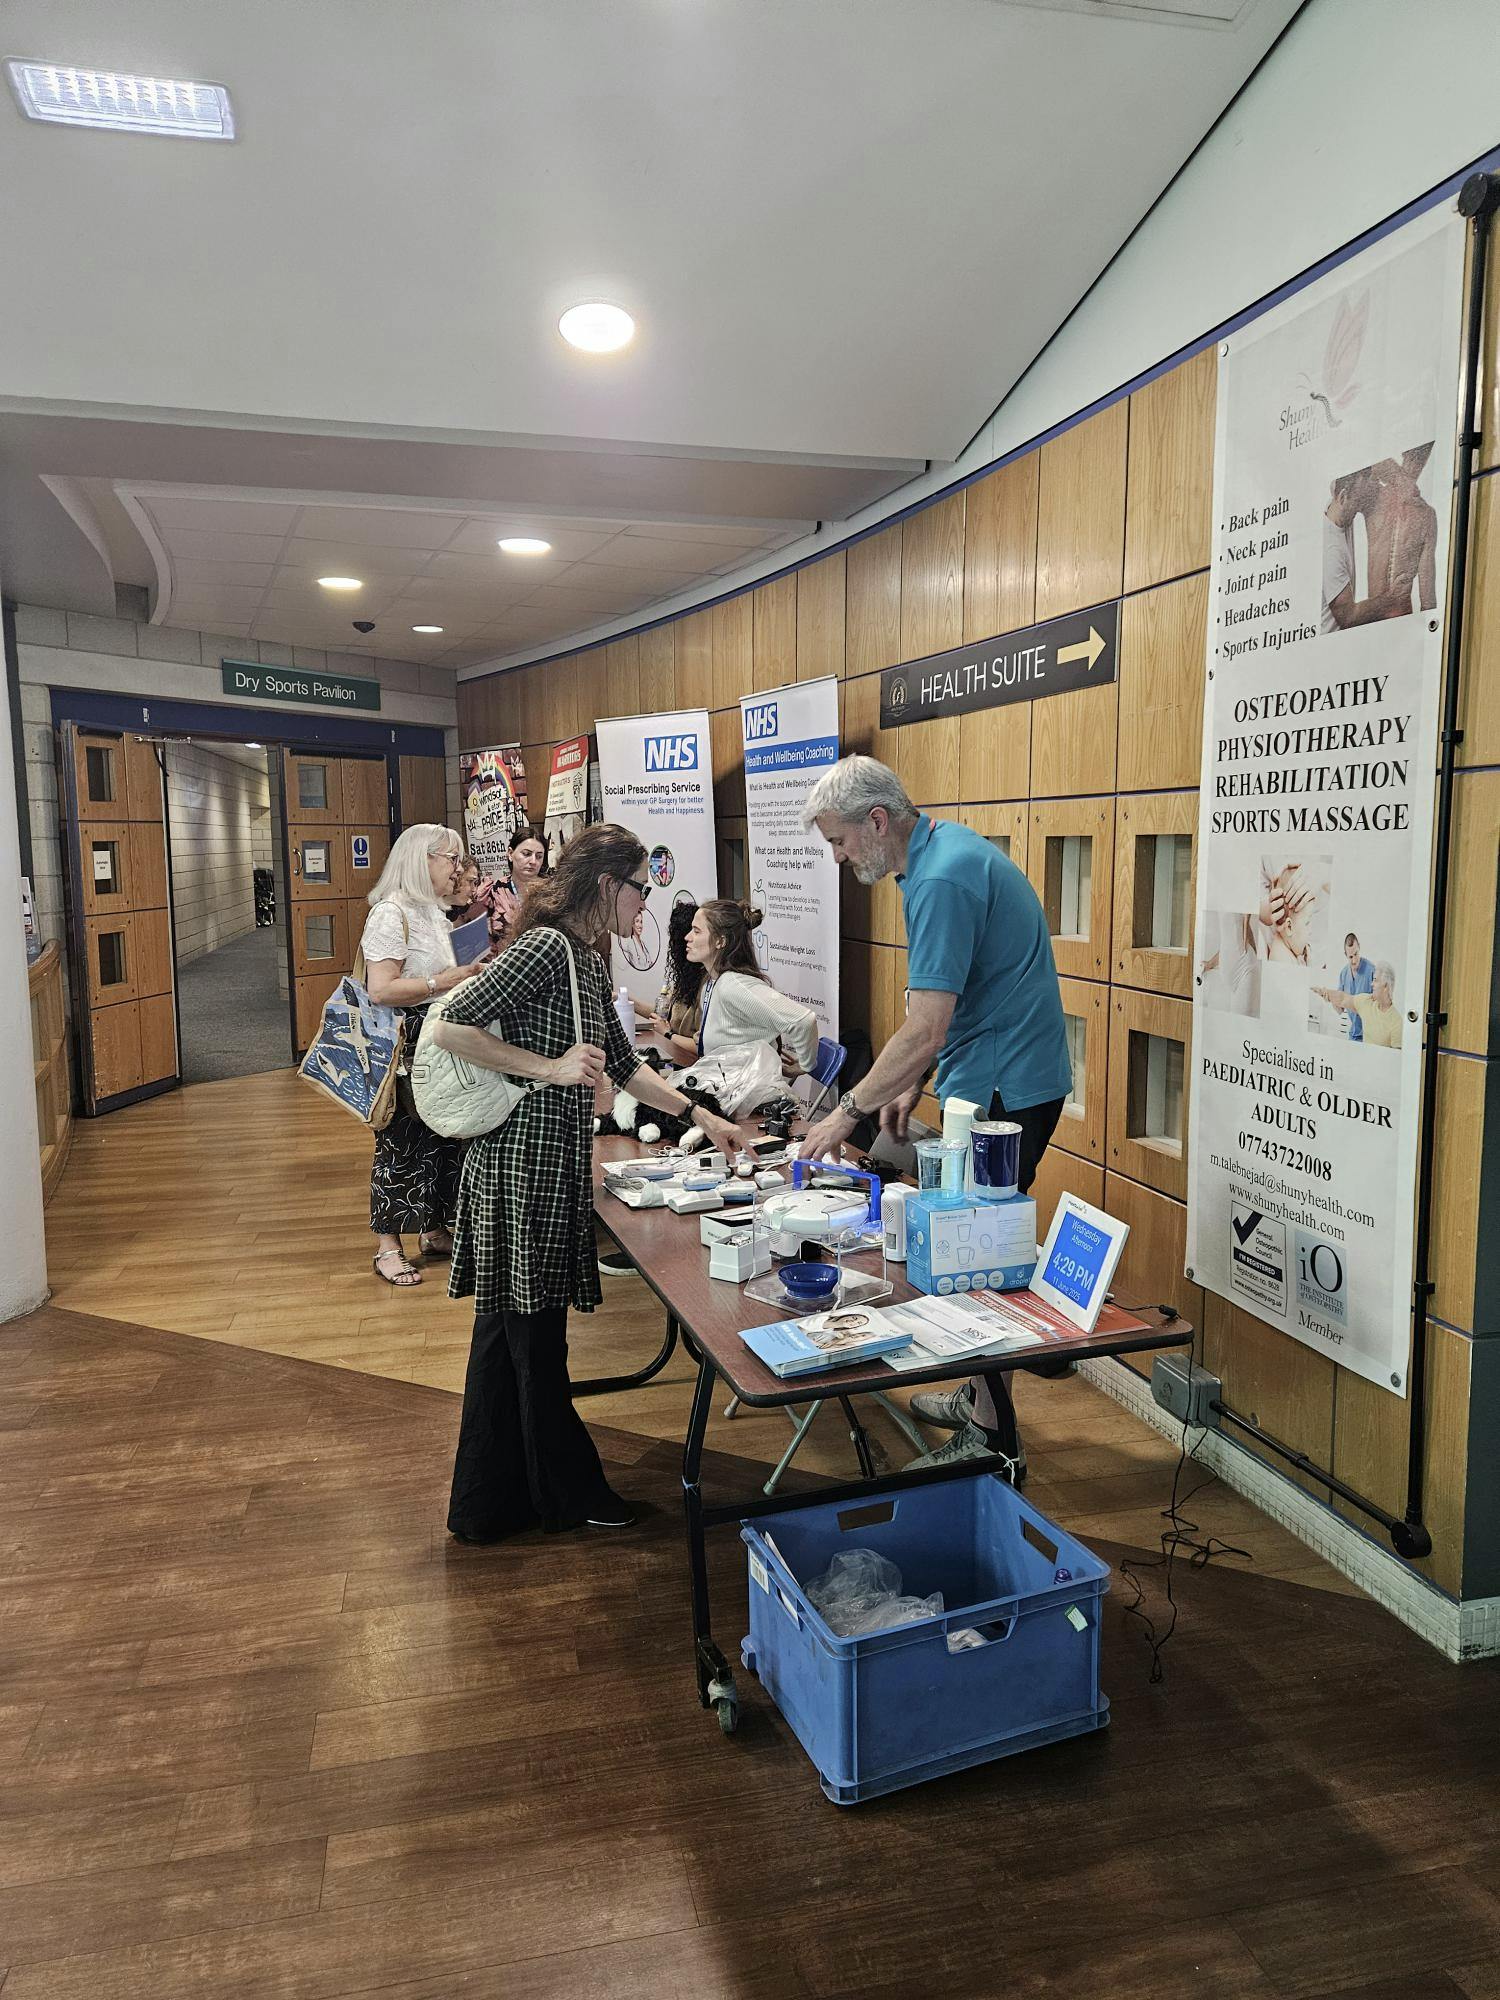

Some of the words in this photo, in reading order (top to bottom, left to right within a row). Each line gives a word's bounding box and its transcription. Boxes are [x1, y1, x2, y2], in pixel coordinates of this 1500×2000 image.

[1229, 509, 1258, 533] Back
[1262, 497, 1290, 526] pain
[1226, 540, 1256, 565] Neck
[1260, 530, 1289, 558] pain
[1225, 573, 1254, 596] Joint
[1259, 564, 1287, 592] pain
[1225, 595, 1290, 627] Headaches
[1223, 637, 1258, 660] Sports
[1262, 623, 1316, 650] Injuries
[235, 672, 260, 692] Dry
[266, 676, 308, 695] Sports
[313, 682, 356, 700] Pavilion
[920, 661, 987, 704] HEALTH
[992, 644, 1046, 688] SUITE
[1234, 674, 1390, 722] OSTEOPATHY
[746, 704, 777, 739] NHS
[647, 736, 696, 770] NHS
[1217, 715, 1412, 762] PHYSIOTHERAPY
[746, 754, 762, 768] Health
[763, 752, 774, 765] and
[775, 748, 804, 764] Wellbeing
[805, 744, 834, 760] Coaching
[604, 784, 626, 795] Social
[628, 784, 669, 796] Prescribing
[672, 782, 700, 793] Service
[785, 779, 807, 788] Wellbeing
[1216, 760, 1410, 798] REHABILITATION
[658, 797, 677, 805] Surgery
[676, 807, 704, 815] Happiness
[482, 810, 503, 828] PRIDE
[1212, 809, 1280, 834] SPORTS
[1286, 804, 1410, 832] MASSAGE
[470, 842, 485, 855] Sat
[486, 840, 506, 854] 26th
[755, 846, 766, 855] What
[777, 846, 791, 855] Health
[793, 846, 803, 855] and
[767, 859, 788, 870] Coaching
[789, 860, 800, 870] help
[768, 881, 787, 889] Nutritional
[788, 882, 802, 890] Advice
[1242, 1040, 1314, 1076] Specialised
[1320, 1058, 1334, 1080] in
[1203, 1058, 1296, 1101] PAEDIATRIC
[1300, 1086, 1312, 1106] &
[1317, 1091, 1393, 1128] OLDER
[1251, 1103, 1317, 1139] ADULTS
[1238, 1130, 1332, 1181] 07743722008
[1210, 1154, 1375, 1228] m.talebnejad@shunyhealth.com
[1229, 1183, 1345, 1241] www.shunyhealth.com
[1071, 1234, 1093, 1253] Afternoon
[1072, 1220, 1101, 1246] Wednesday
[1053, 1252, 1076, 1278] 4:29
[1074, 1266, 1095, 1291] PM
[1247, 1257, 1275, 1275] REGISTERED
[1058, 1280, 1068, 1296] June
[1068, 1287, 1080, 1301] 2025
[1298, 1310, 1344, 1345] Member
